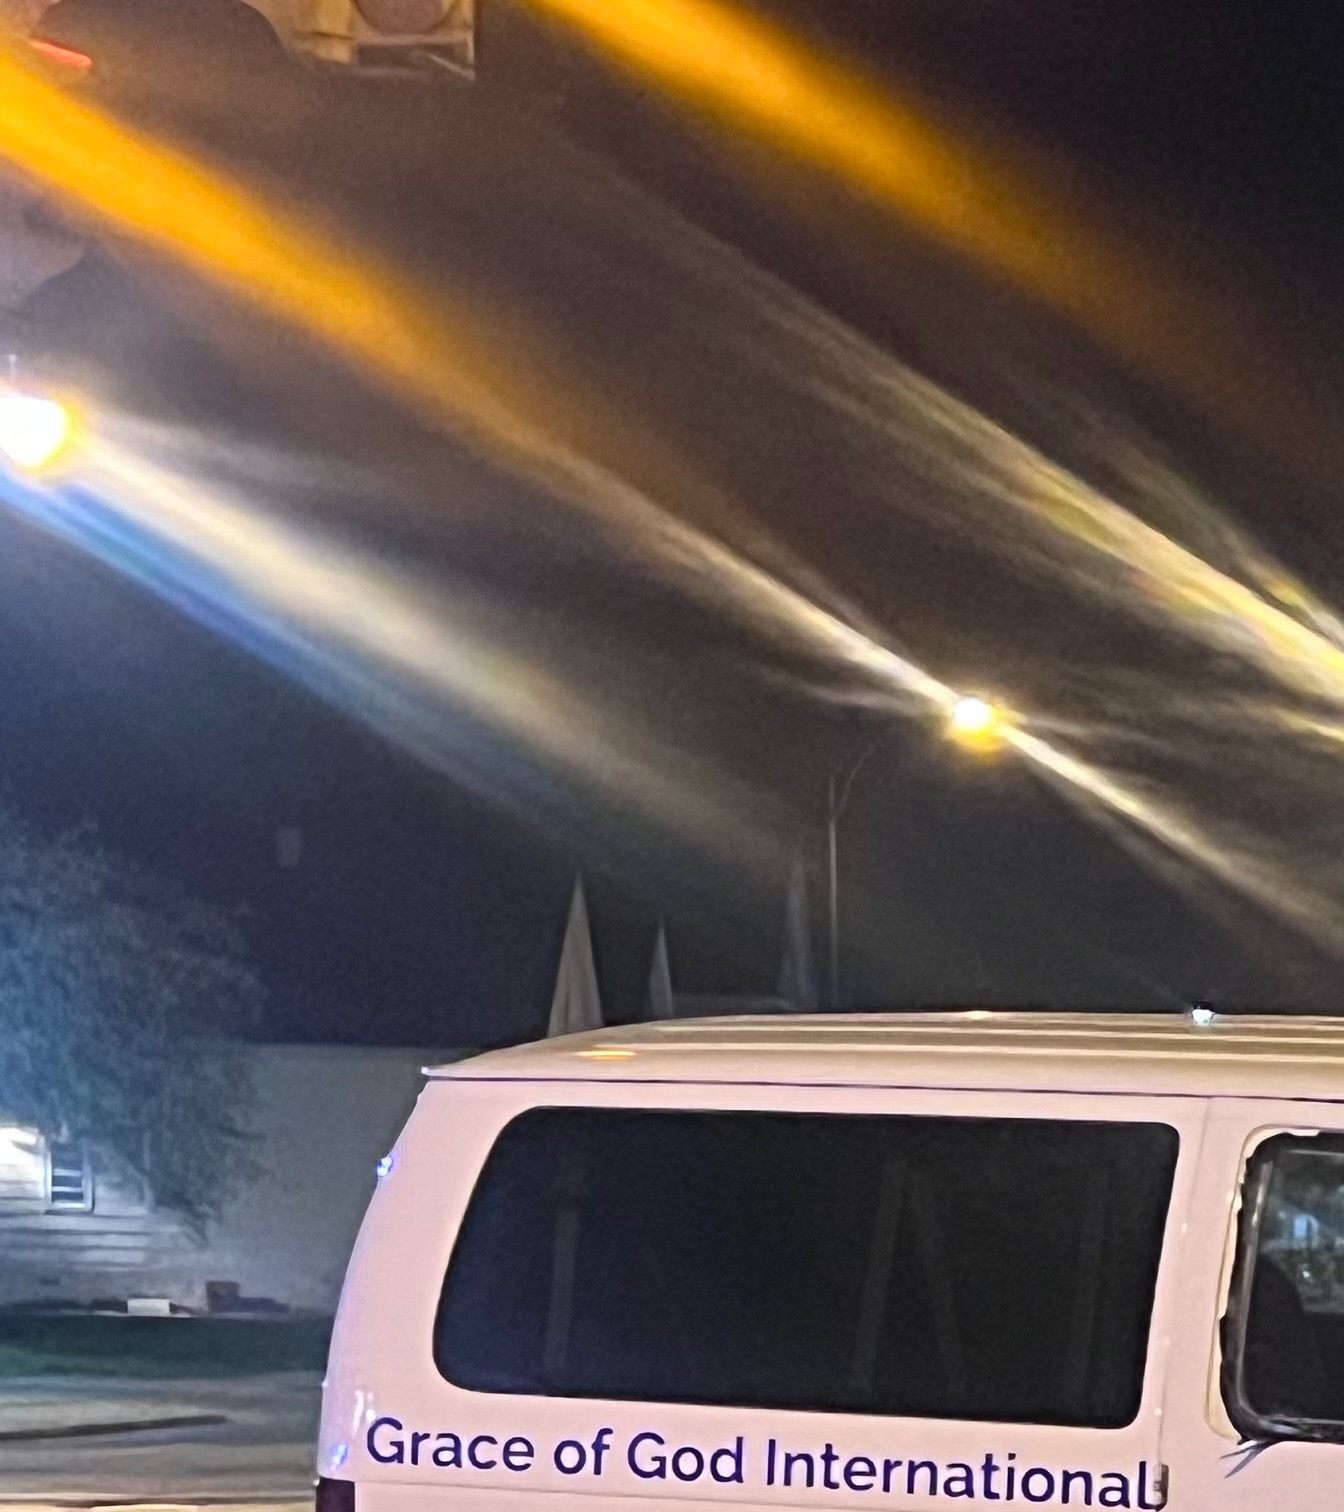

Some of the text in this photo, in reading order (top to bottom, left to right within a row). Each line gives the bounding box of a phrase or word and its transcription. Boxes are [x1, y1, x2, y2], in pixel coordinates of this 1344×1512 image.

[366, 1416, 1158, 1511] Grace of God International
